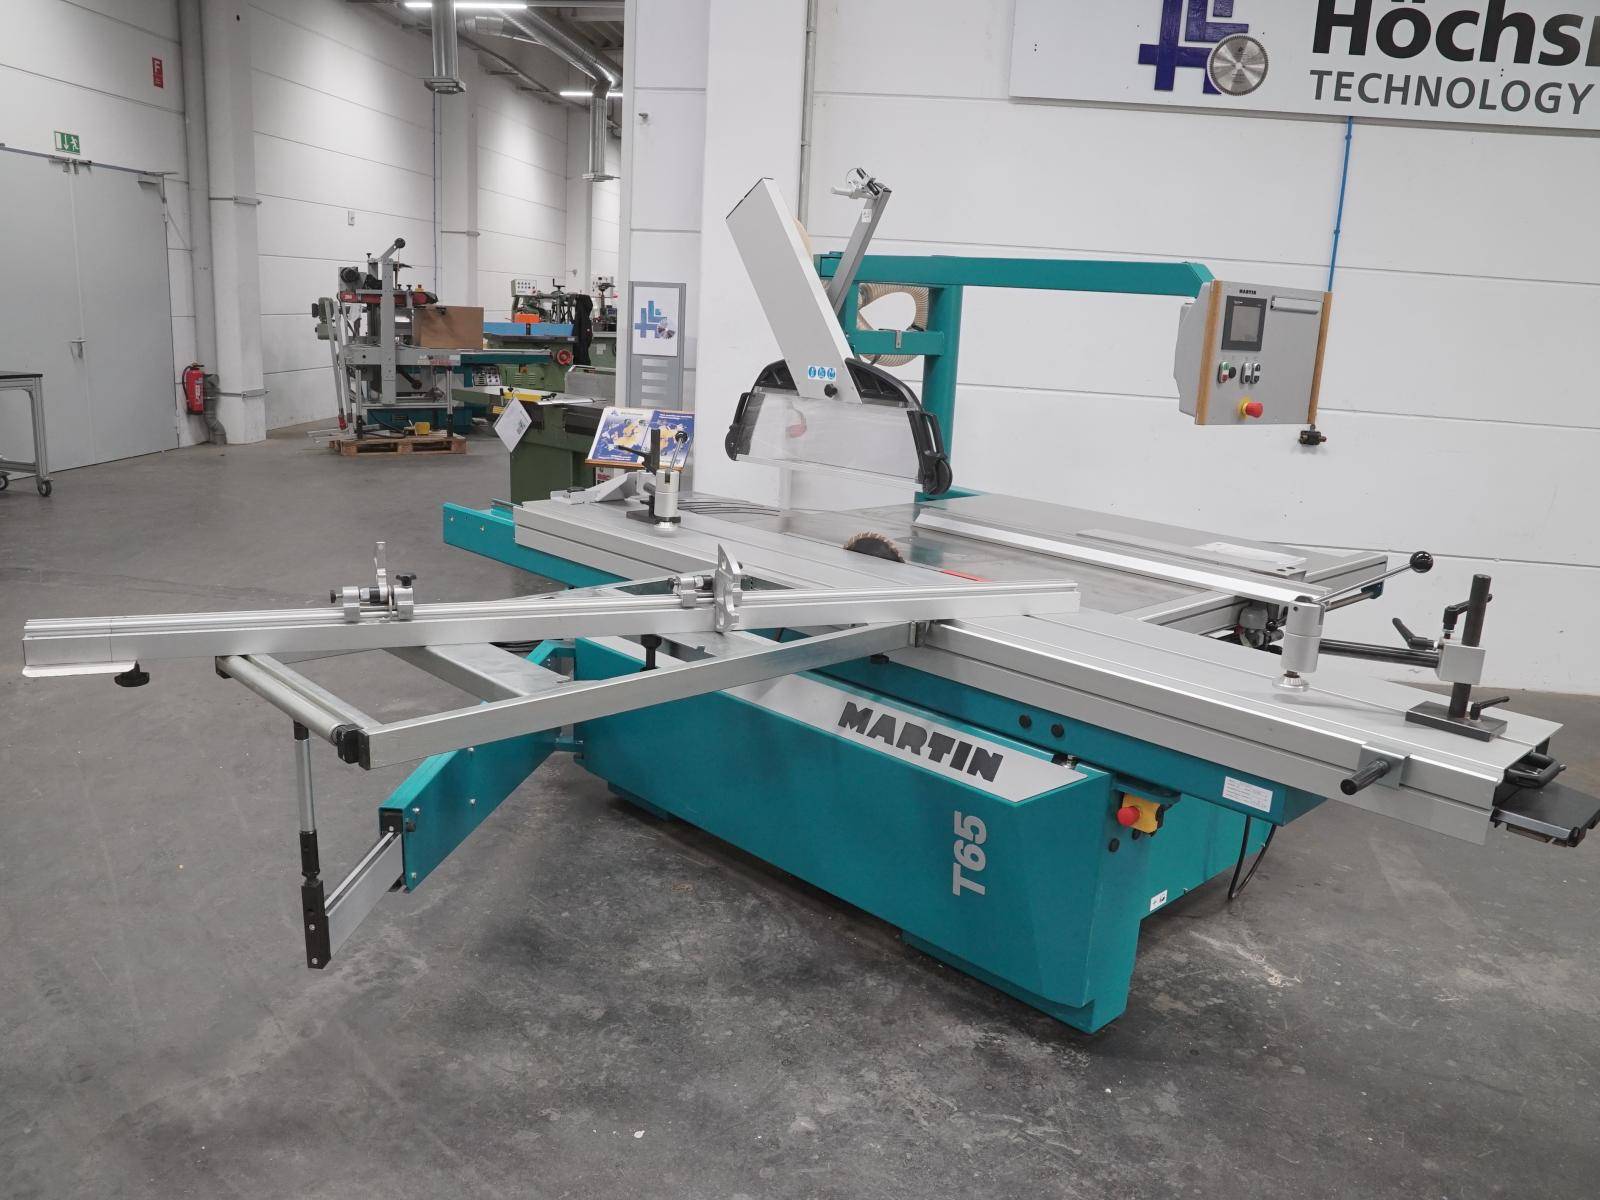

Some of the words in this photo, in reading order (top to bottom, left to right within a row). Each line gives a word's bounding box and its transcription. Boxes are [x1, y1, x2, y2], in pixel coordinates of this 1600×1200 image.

[1312, 0, 1600, 67] Höchs
[1309, 69, 1595, 115] TECHNOLOGY
[838, 702, 1003, 782] MARTIN
[952, 811, 987, 896] T65
